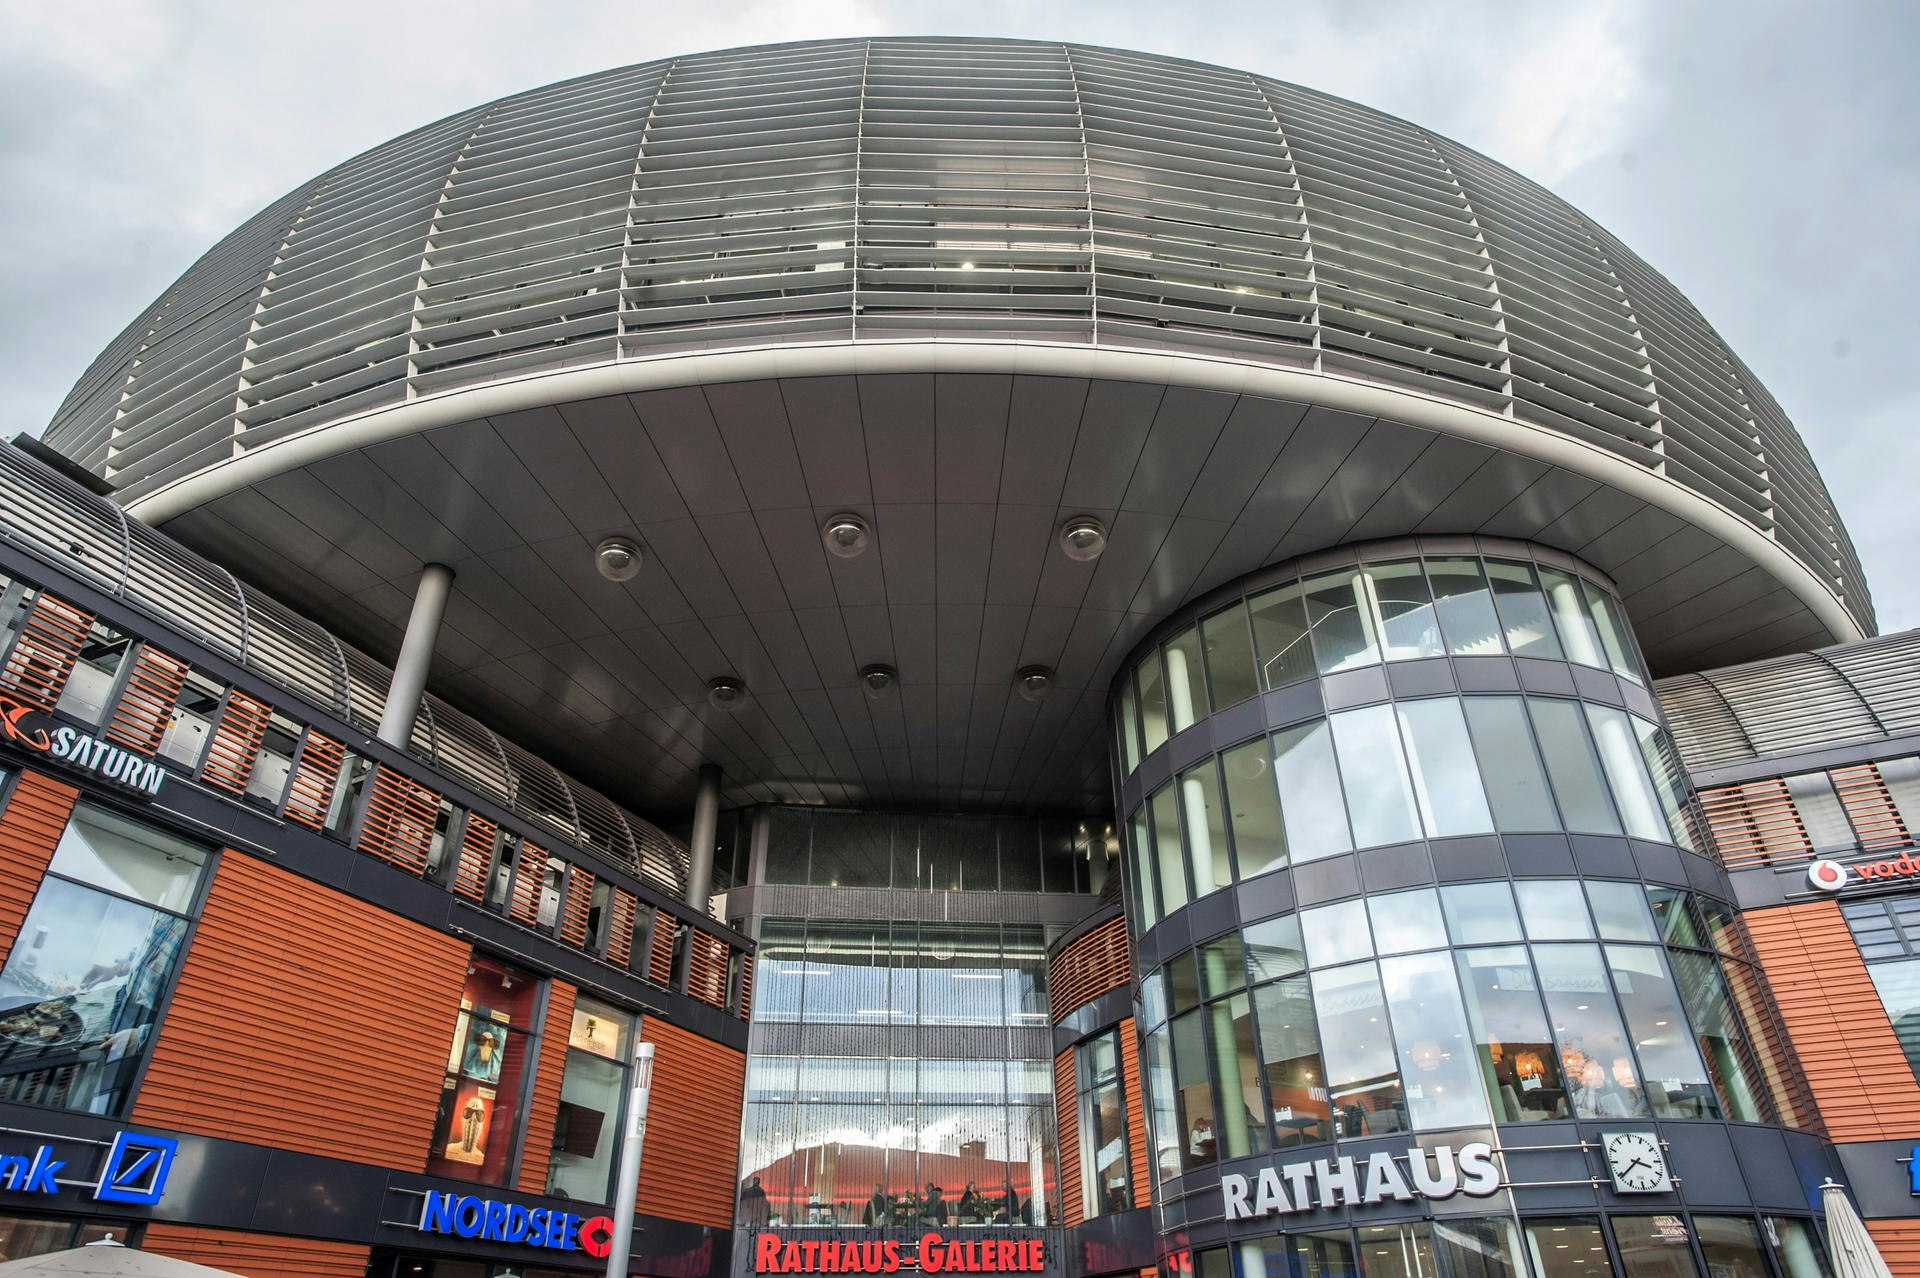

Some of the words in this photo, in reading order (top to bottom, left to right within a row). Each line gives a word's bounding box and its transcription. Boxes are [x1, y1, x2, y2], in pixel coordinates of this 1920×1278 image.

[51, 726, 166, 795] SATURN
[1221, 1142, 1500, 1221] RATHAUS
[419, 1189, 580, 1251] NORDSEE
[755, 1232, 1046, 1274] RATHAUS-GALERIE
